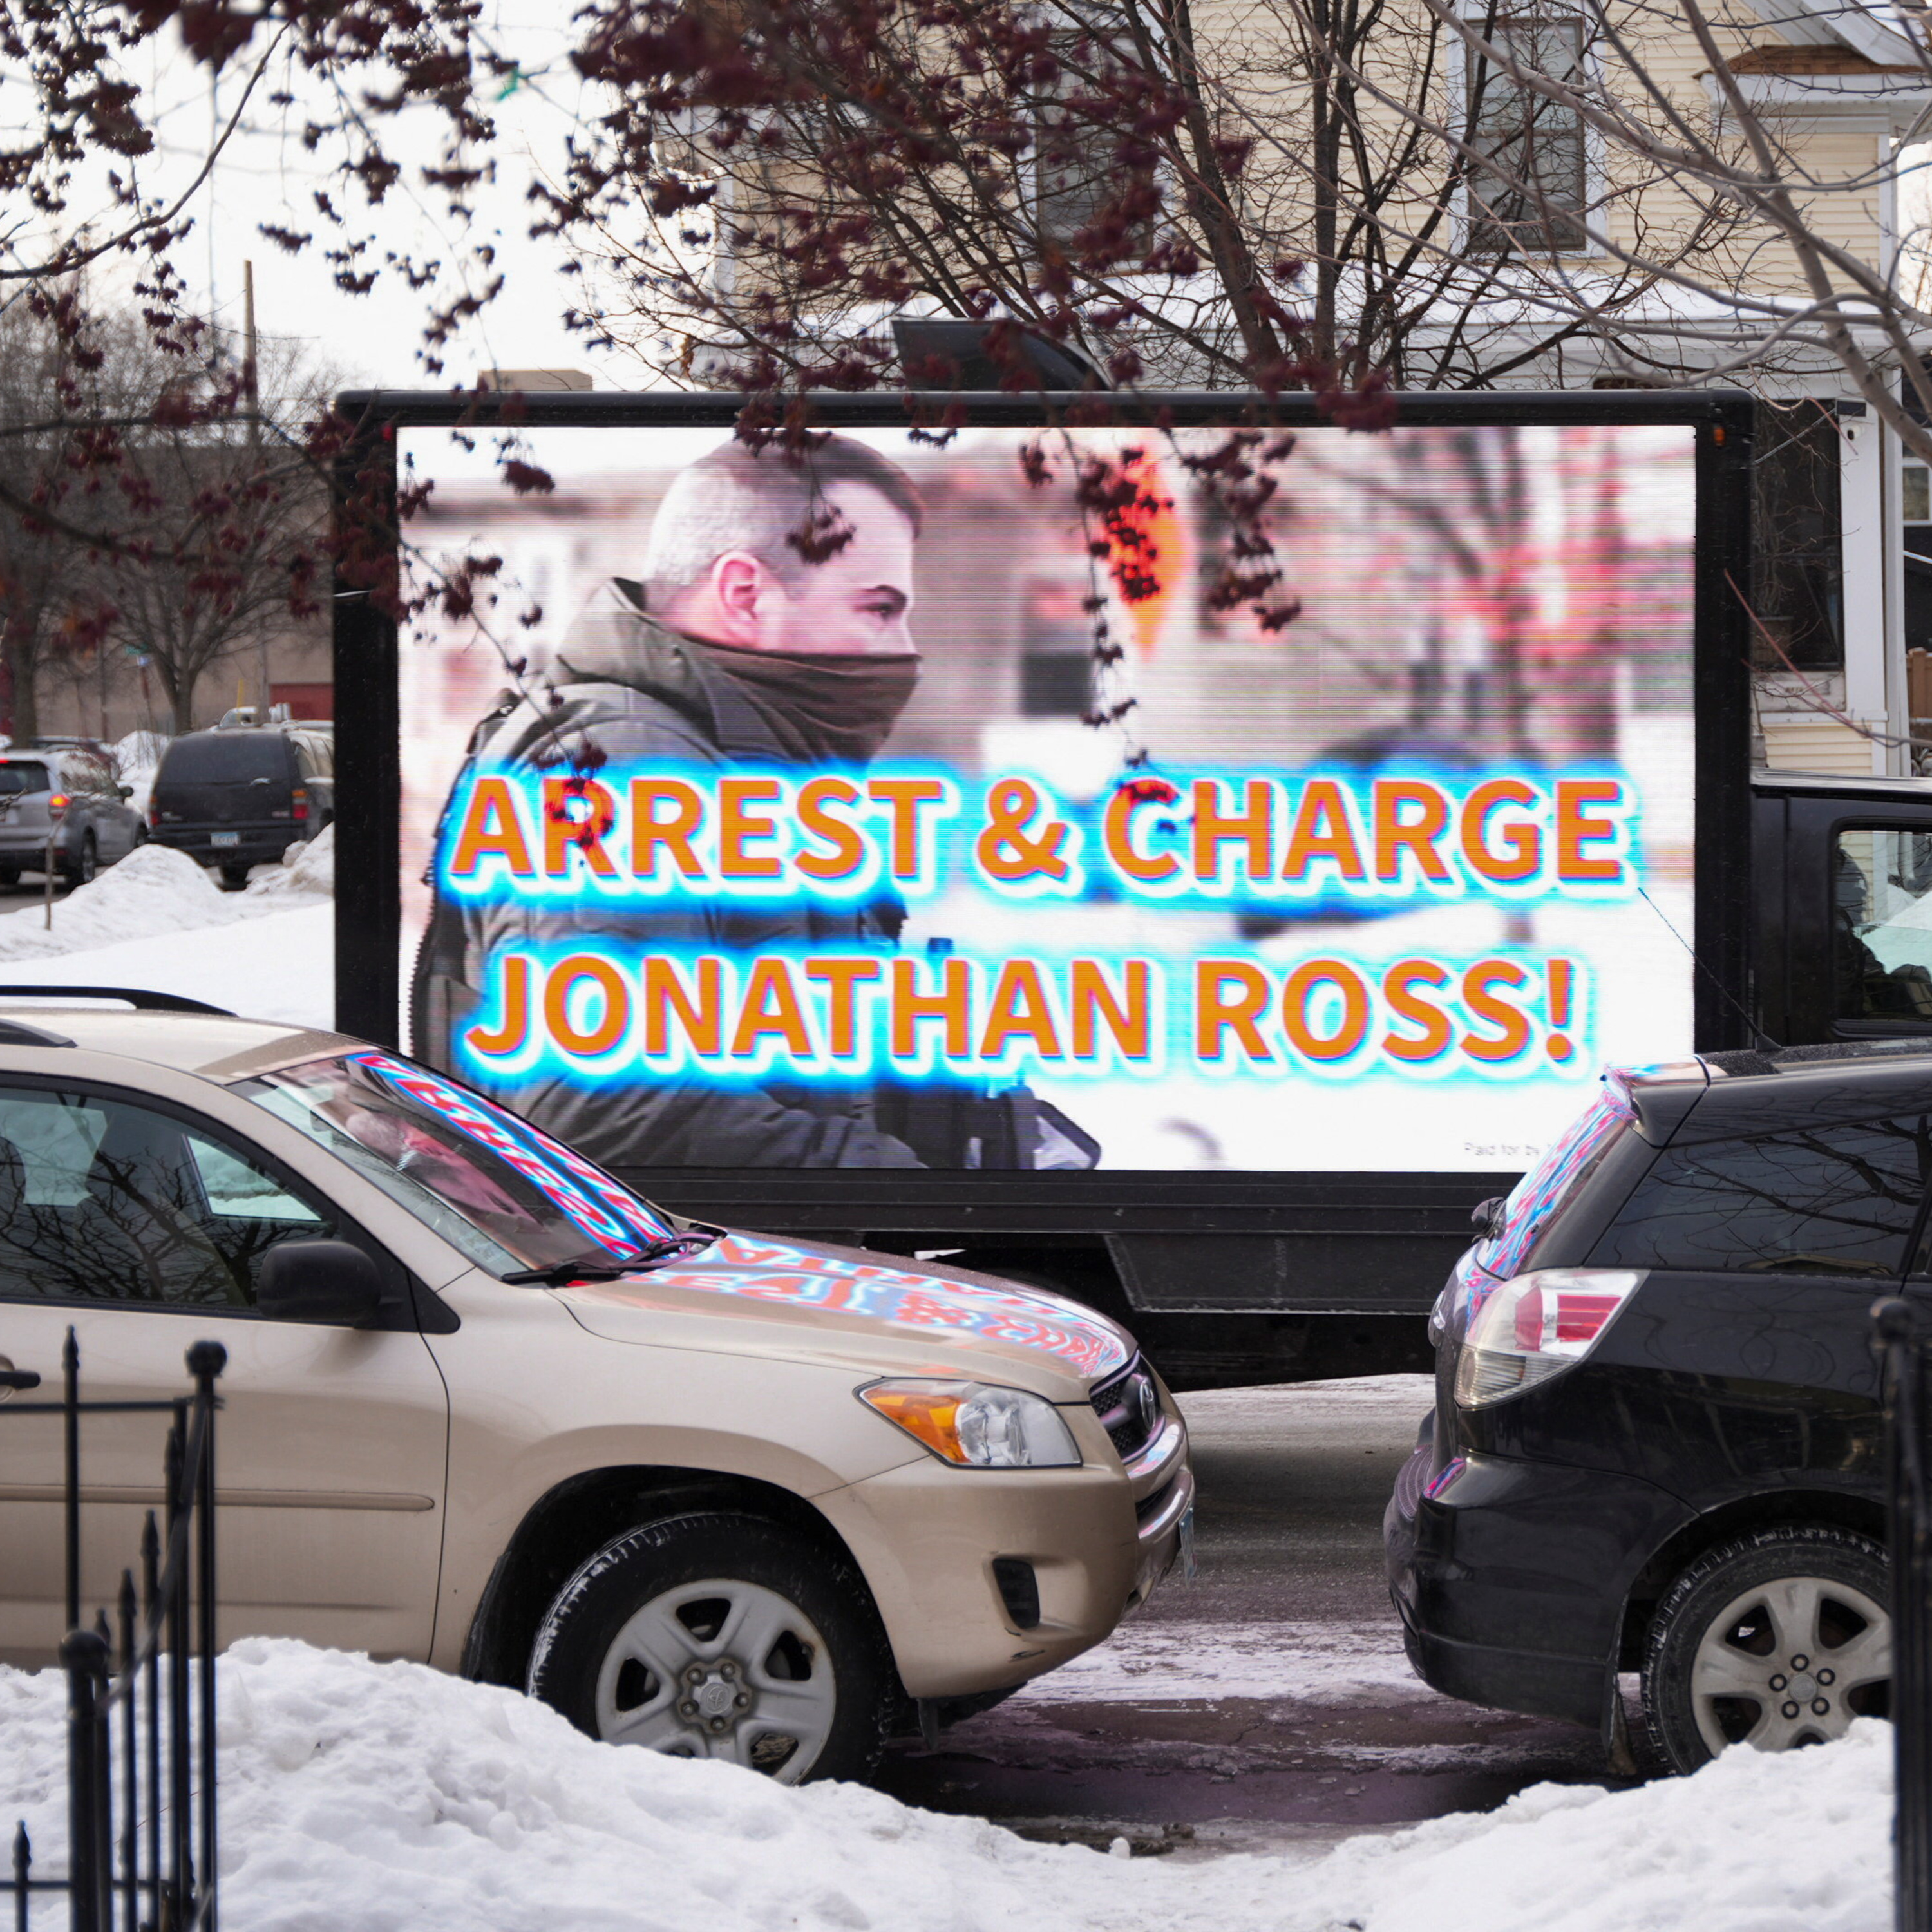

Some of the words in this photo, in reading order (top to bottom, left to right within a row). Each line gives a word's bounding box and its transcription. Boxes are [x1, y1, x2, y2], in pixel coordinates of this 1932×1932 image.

[450, 777, 943, 878] ARREST
[976, 778, 1068, 879] &
[1104, 779, 1620, 880] CHARGE
[464, 955, 1148, 1057] JONATHAN
[1196, 958, 1573, 1061] ROSS!
